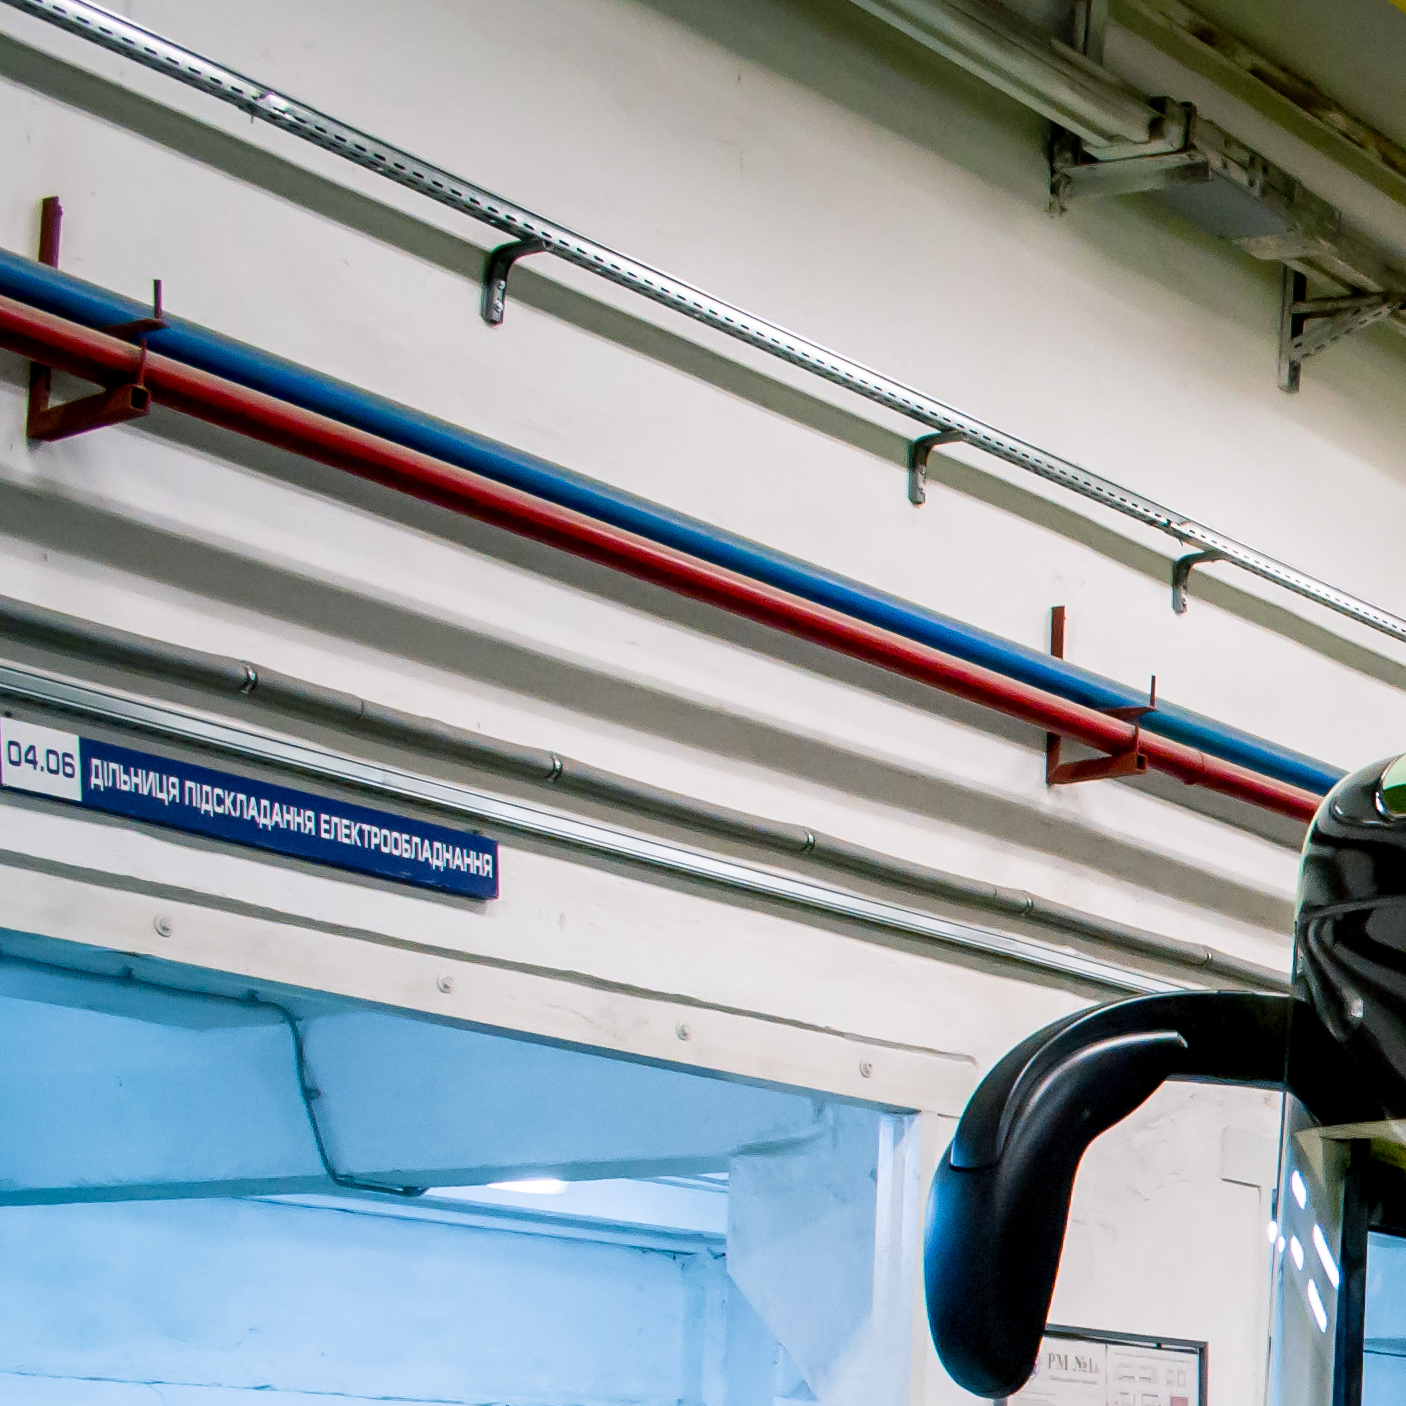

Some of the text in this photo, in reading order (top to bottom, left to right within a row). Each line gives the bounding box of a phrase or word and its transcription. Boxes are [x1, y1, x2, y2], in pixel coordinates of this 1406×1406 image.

[6, 739, 77, 779] 04.06
[88, 756, 494, 879] ДІЛЬНИЦЯ ПІДСКЛАДАННЯ ЕЛЕКТРООБЛАДНАННЯ
